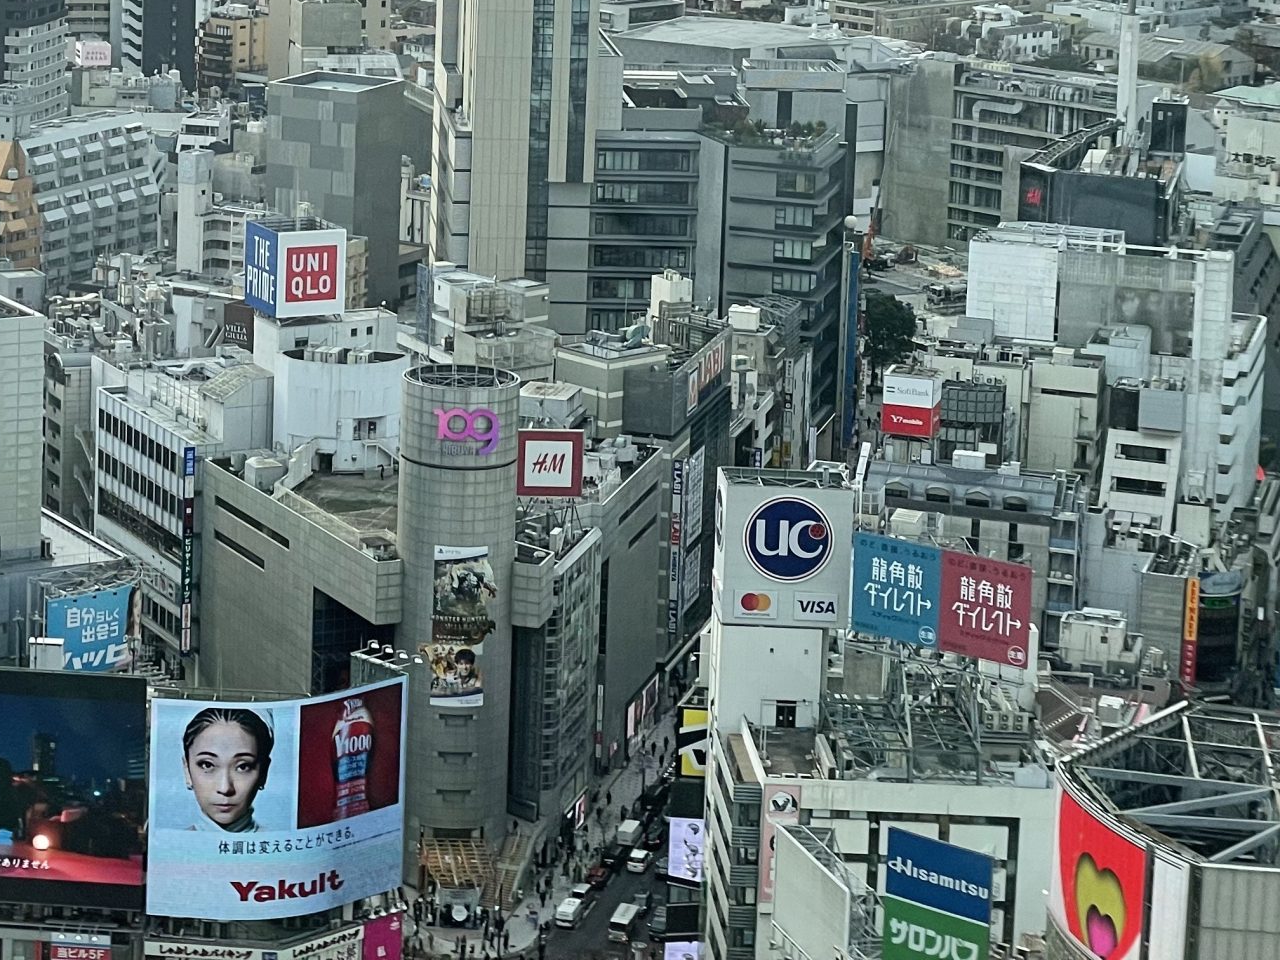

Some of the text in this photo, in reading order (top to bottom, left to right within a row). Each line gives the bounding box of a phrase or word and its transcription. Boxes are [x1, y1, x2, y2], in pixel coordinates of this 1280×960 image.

[254, 236, 270, 270] THE
[292, 252, 328, 273] UNI
[247, 265, 274, 305] PRIME
[291, 275, 331, 298] QLO
[225, 324, 247, 334] VILLA
[699, 340, 725, 389] LABI
[897, 386, 929, 397] SoftBank
[433, 407, 500, 456] 109
[532, 453, 566, 474] H&M
[673, 471, 682, 494] LABI
[872, 557, 924, 590] 龍角散
[797, 600, 835, 615] VISA
[864, 583, 932, 617] ダイレクト
[960, 576, 1013, 610] 龍角散
[67, 607, 119, 629] 自分らしく
[82, 621, 119, 644] 出会う
[952, 602, 1022, 637] ダイレクト
[219, 827, 355, 855] 体調は変えることができる。
[230, 870, 345, 903] Yakult
[887, 856, 989, 900] Hisamitsu
